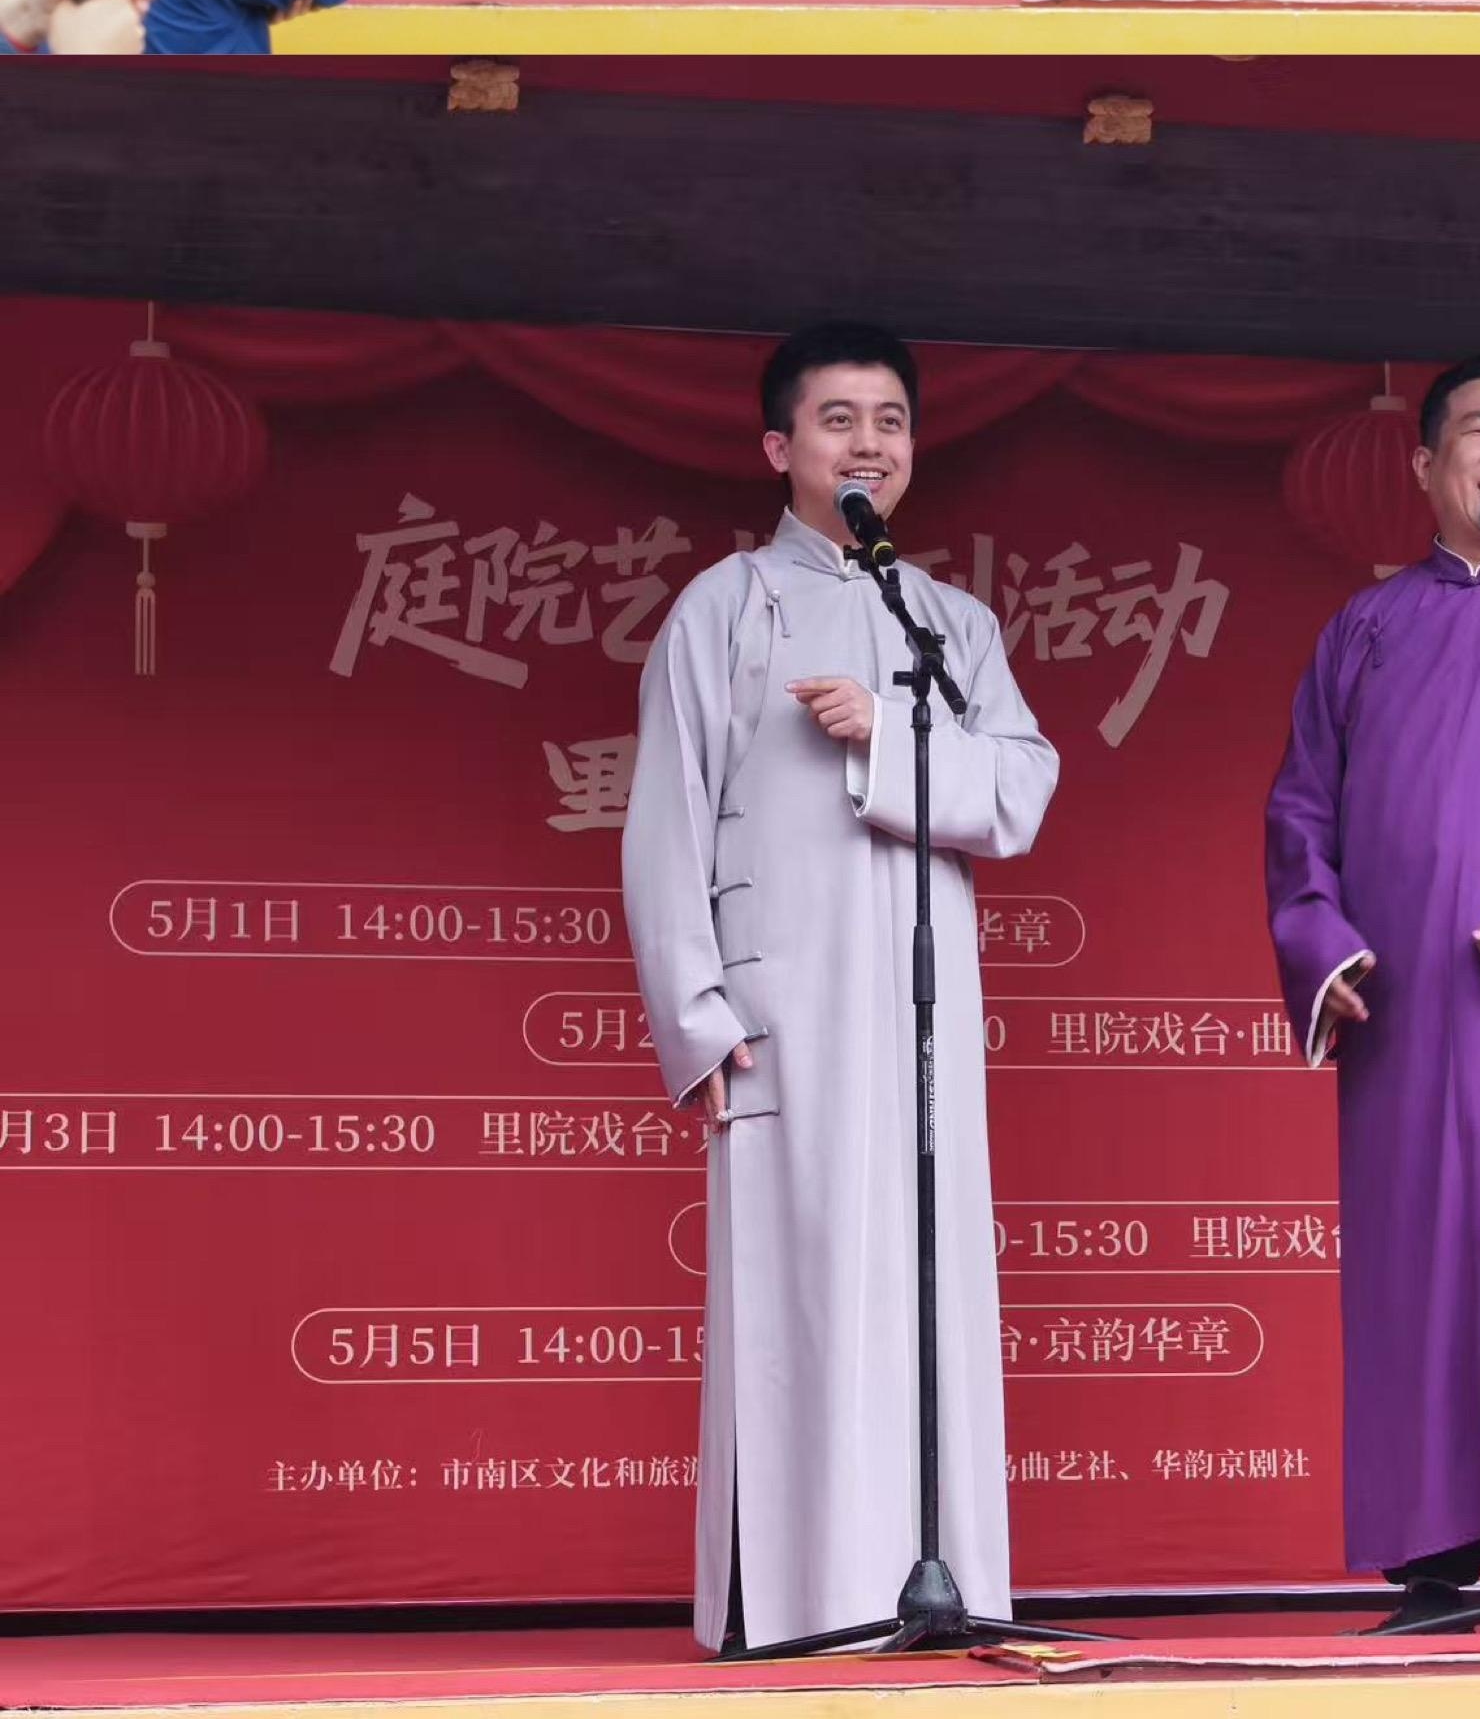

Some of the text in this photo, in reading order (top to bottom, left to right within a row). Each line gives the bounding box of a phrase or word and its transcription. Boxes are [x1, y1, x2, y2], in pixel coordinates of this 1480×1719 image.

[145, 896, 301, 943] 5月1日
[336, 901, 613, 947] 14:00-15:30
[154, 1112, 436, 1155] 14:00-15:30
[1188, 1215, 1341, 1260] 里院戏
[327, 1323, 482, 1369] 5月5日
